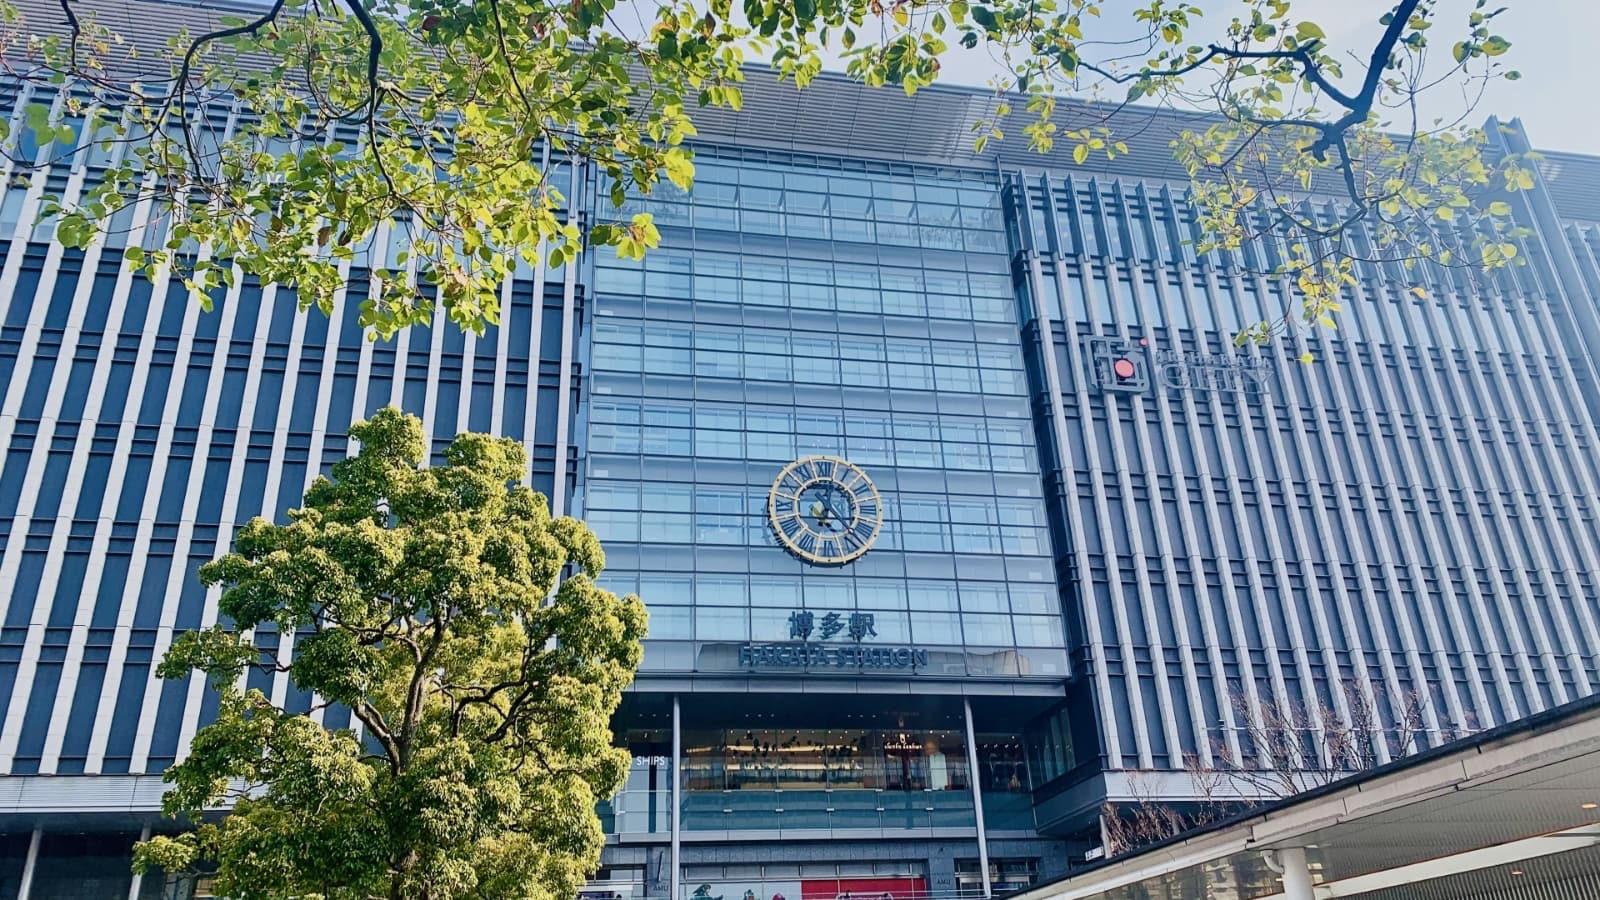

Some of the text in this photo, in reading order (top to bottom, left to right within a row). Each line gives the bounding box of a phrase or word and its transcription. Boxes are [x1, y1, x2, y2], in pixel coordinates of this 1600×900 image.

[1161, 364, 1275, 394] CITY
[788, 610, 878, 640] 博多駅
[738, 646, 928, 668] HAKATA STATION
[636, 755, 665, 766] SHIPS
